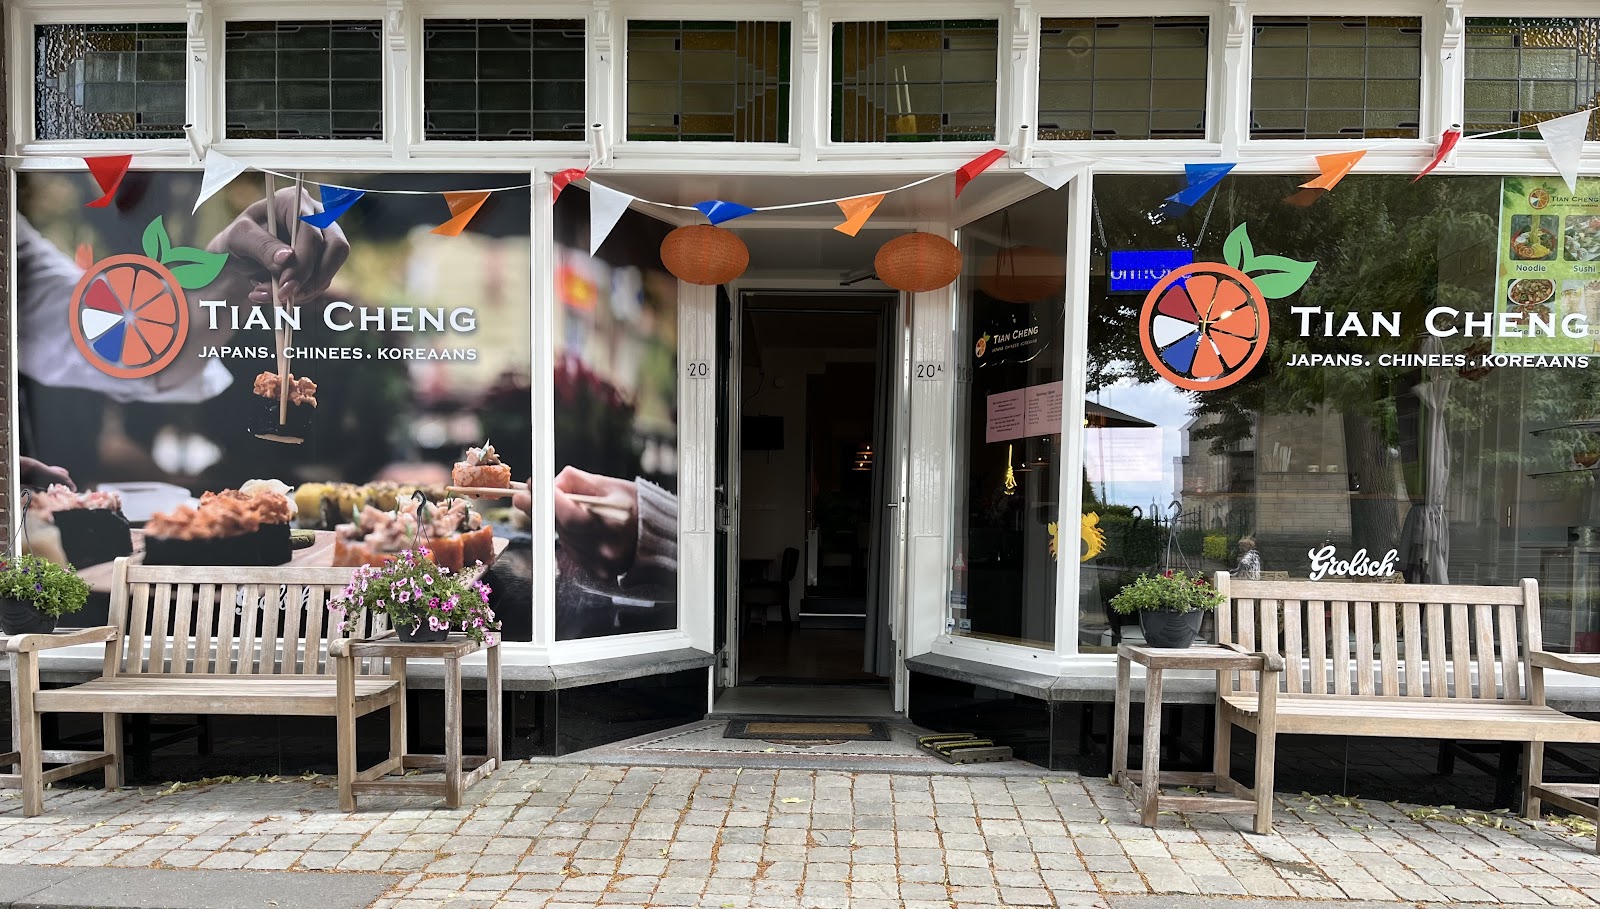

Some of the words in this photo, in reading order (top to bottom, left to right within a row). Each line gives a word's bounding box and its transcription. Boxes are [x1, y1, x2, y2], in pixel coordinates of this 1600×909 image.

[1516, 264, 1546, 272] Noodle
[1573, 265, 1596, 273] Sushi
[199, 300, 301, 331] TIAN
[323, 301, 476, 332] CHENG
[1290, 305, 1402, 337] TIAN
[1424, 306, 1590, 339] CHENG
[993, 333, 1011, 345] TIAN
[1012, 326, 1039, 339] CHENG
[377, 348, 477, 360] KOREAANS
[1482, 355, 1589, 368] KOREAANS
[1308, 545, 1400, 581] Grolsch
